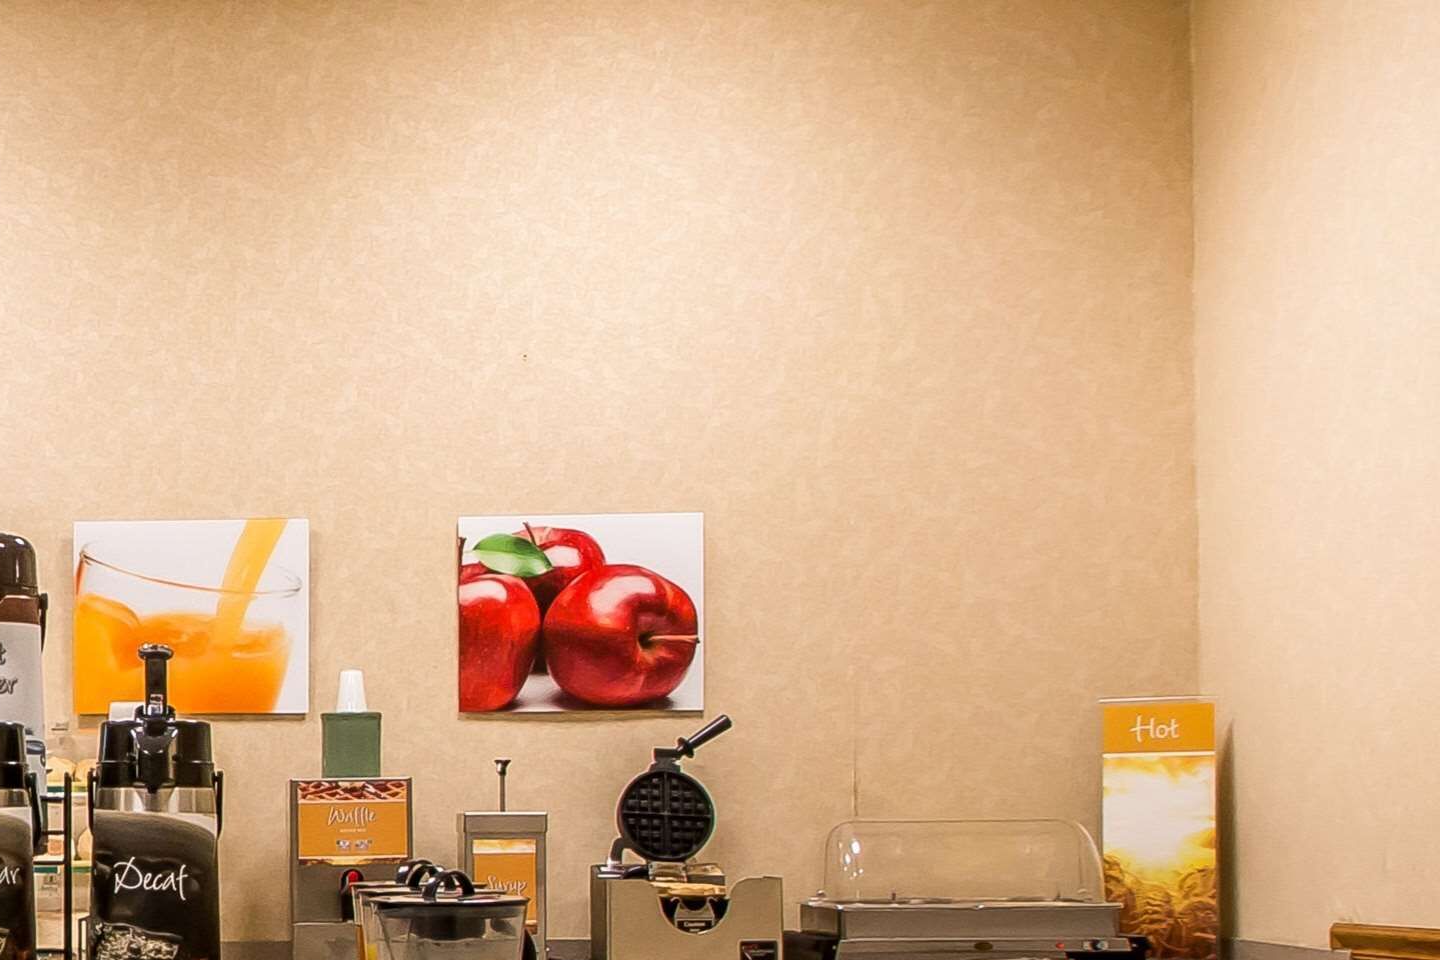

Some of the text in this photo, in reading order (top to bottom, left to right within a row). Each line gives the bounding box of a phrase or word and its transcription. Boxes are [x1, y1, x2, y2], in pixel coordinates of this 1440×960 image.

[1129, 715, 1179, 742] Hot
[327, 806, 377, 826] Waffle
[114, 856, 189, 900] Decaf
